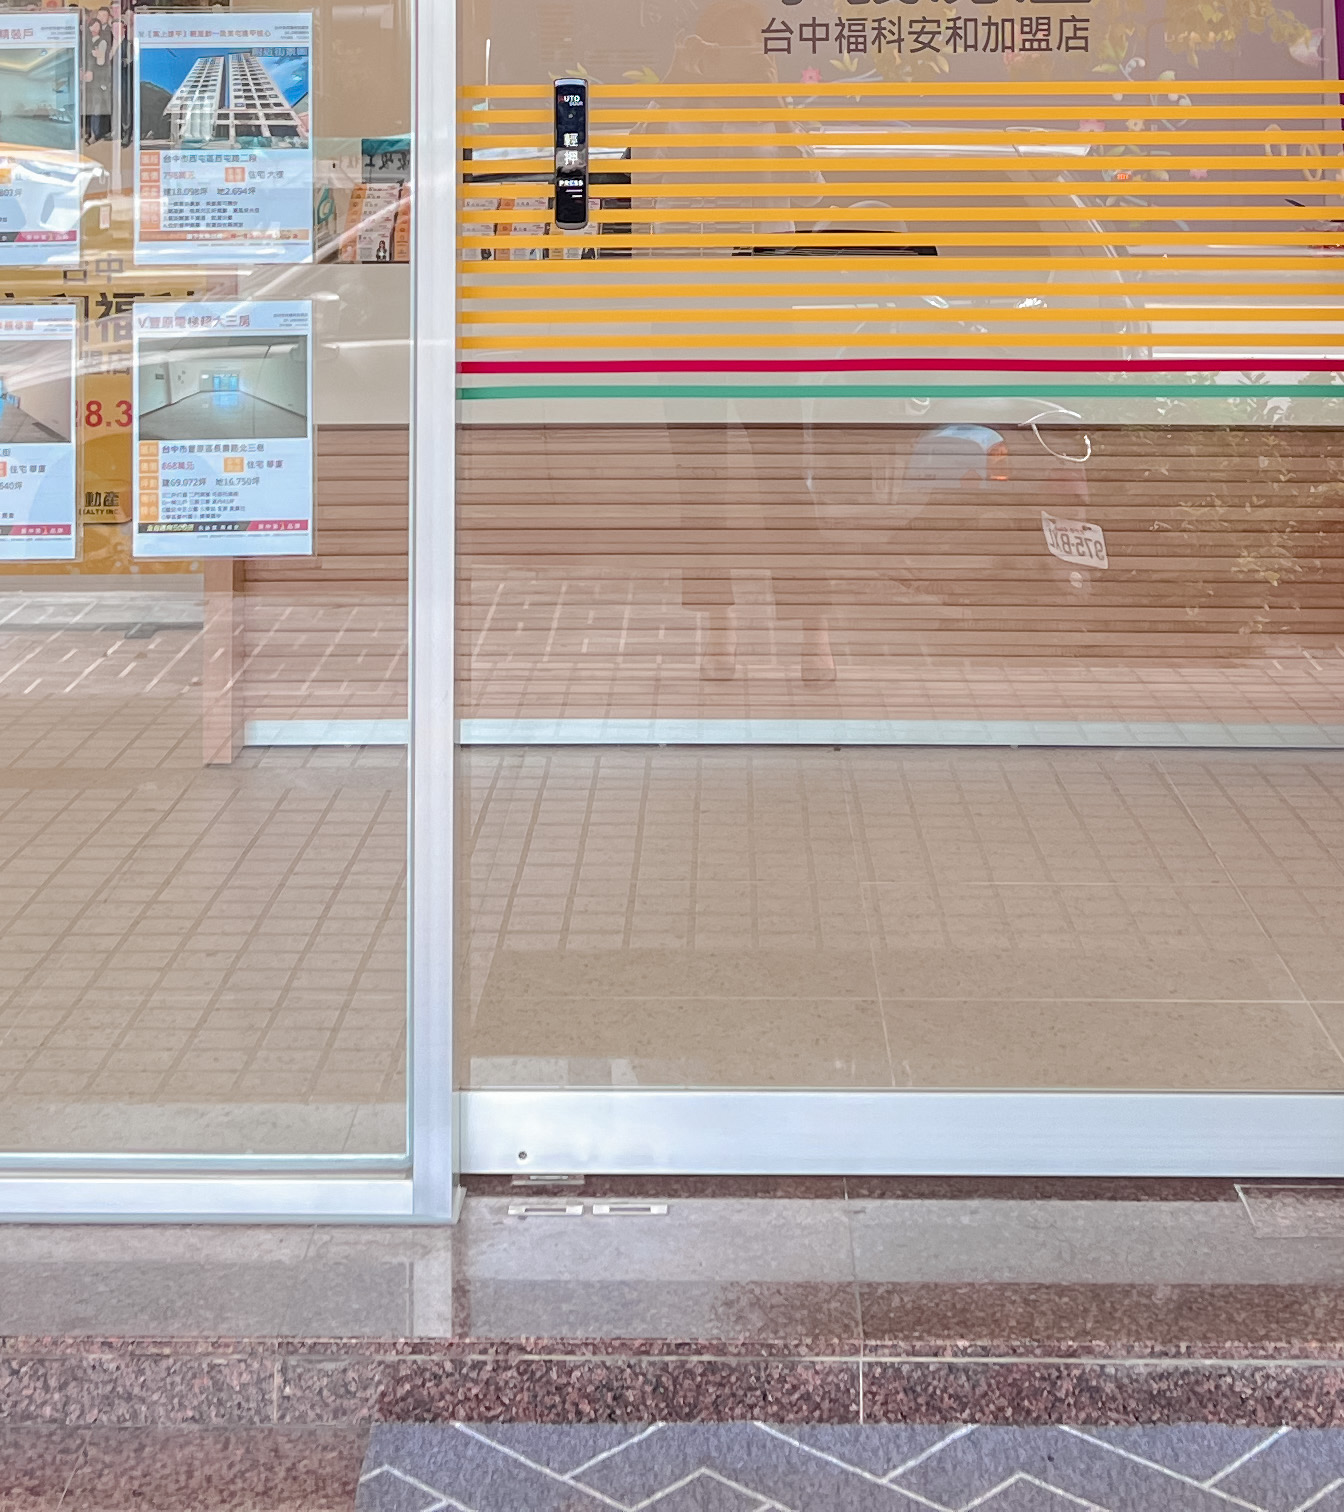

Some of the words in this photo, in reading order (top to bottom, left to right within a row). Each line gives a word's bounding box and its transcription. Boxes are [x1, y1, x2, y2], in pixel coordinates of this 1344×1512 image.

[760, 15, 1090, 54] 台中福科安和加盟店
